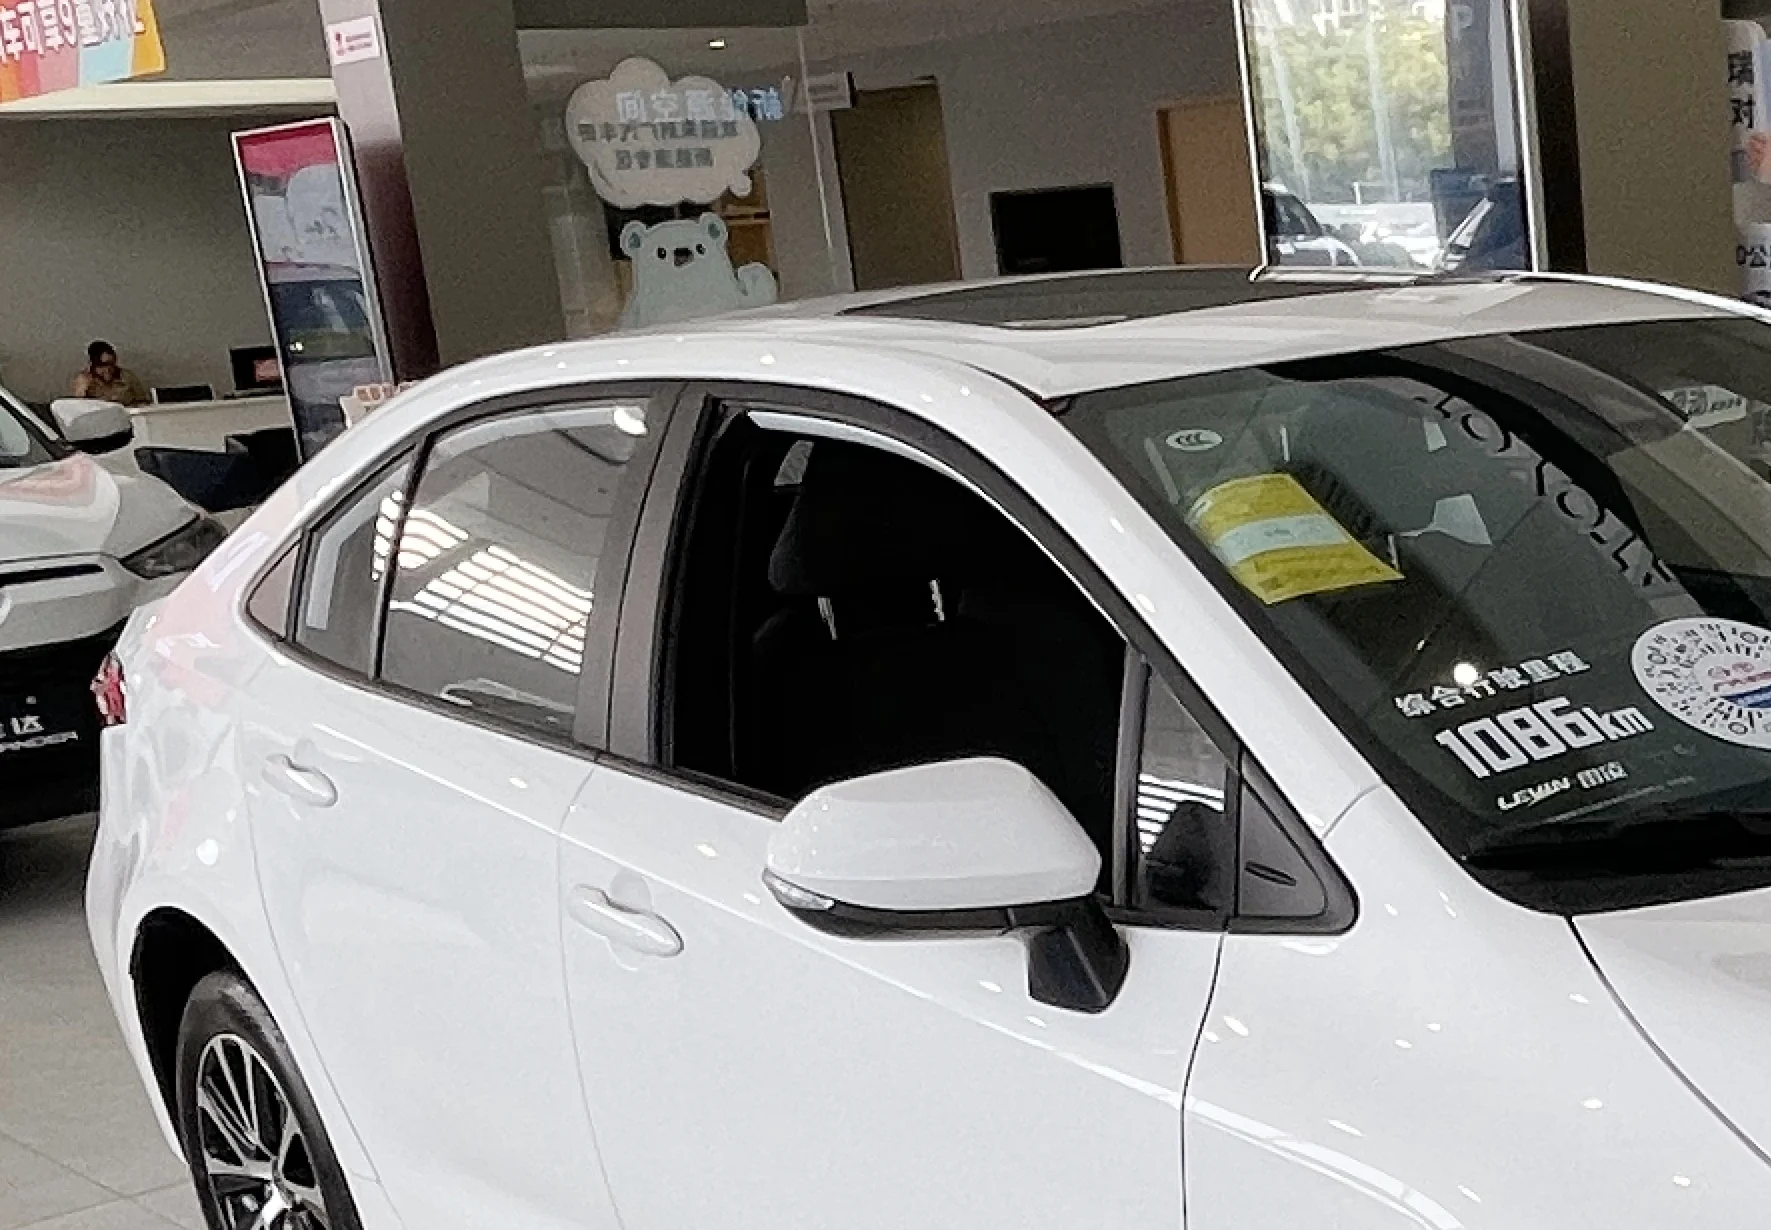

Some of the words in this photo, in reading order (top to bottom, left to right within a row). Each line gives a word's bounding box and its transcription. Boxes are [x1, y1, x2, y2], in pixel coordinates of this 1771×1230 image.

[1394, 650, 1592, 718] 综合行驶里程
[1434, 696, 1655, 778] 1086km
